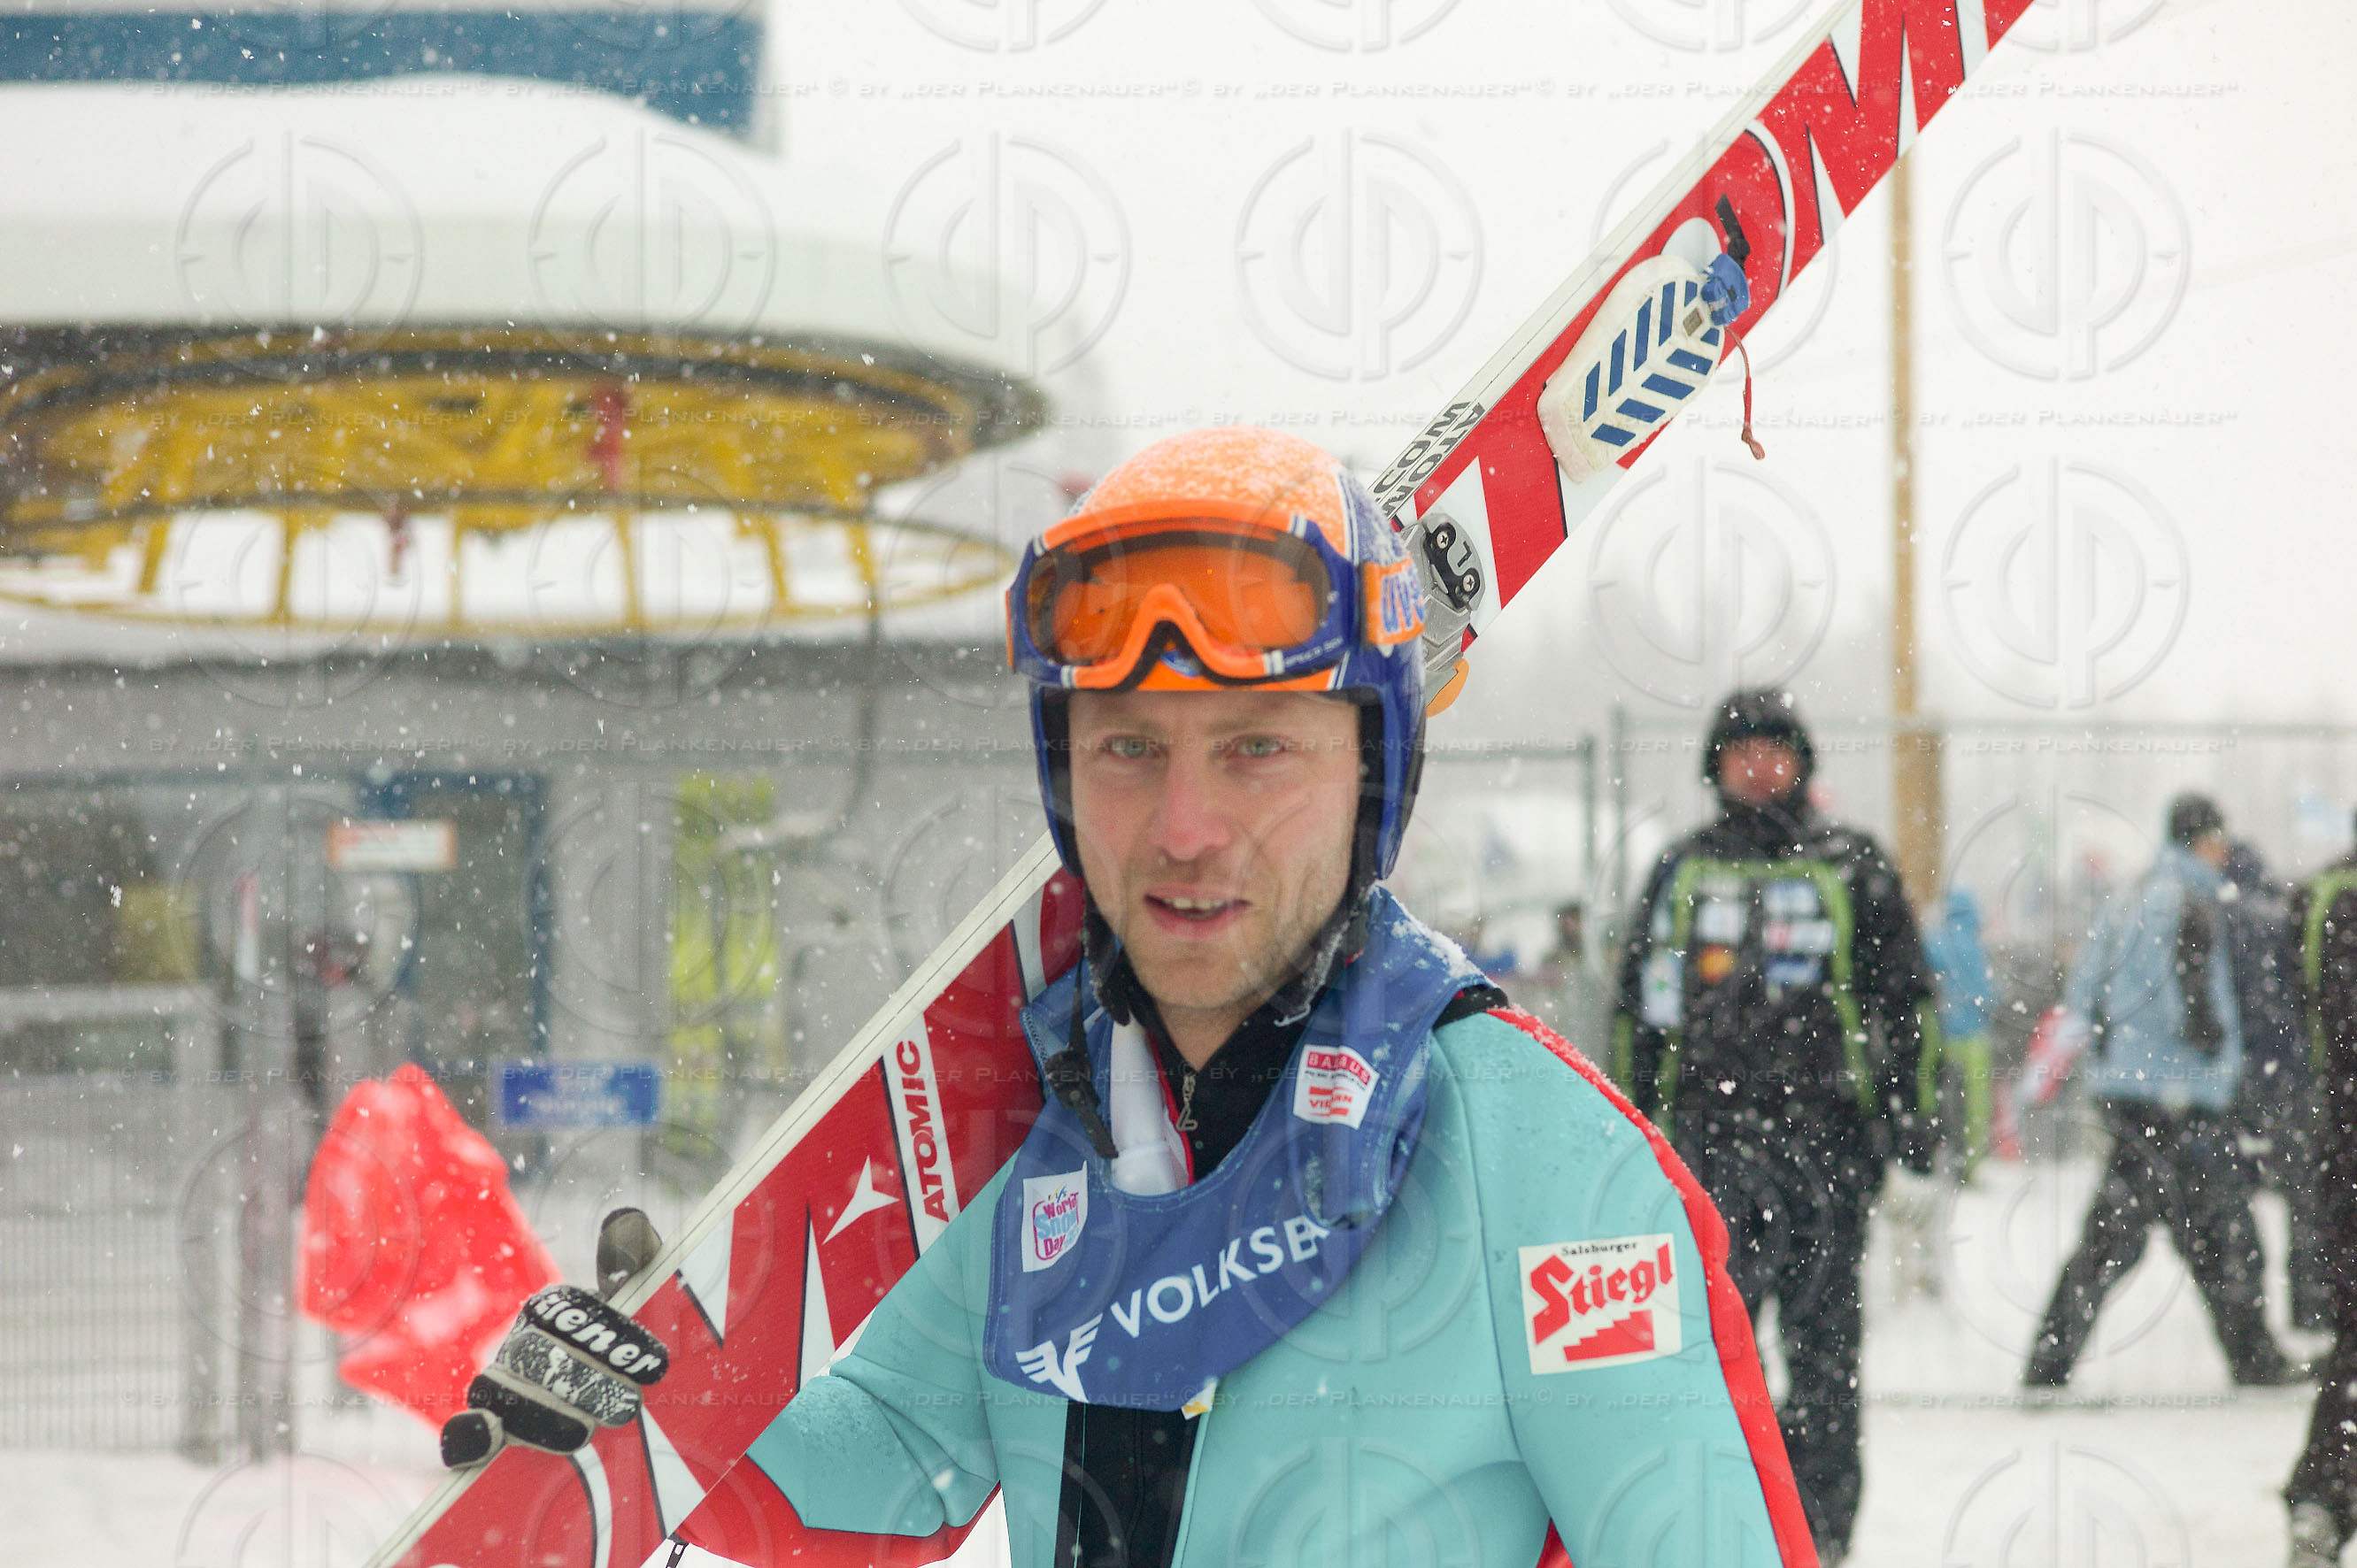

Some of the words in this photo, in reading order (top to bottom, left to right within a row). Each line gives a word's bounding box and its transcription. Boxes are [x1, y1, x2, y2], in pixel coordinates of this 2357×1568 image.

[1382, 403, 1485, 517] ATOM
[896, 1040, 950, 1224] ATOMIC
[1043, 1191, 1079, 1219] World
[1044, 1234, 1067, 1257] Day
[1110, 1215, 1330, 1339] VOLKSB
[1530, 1242, 1674, 1345] Stiegl
